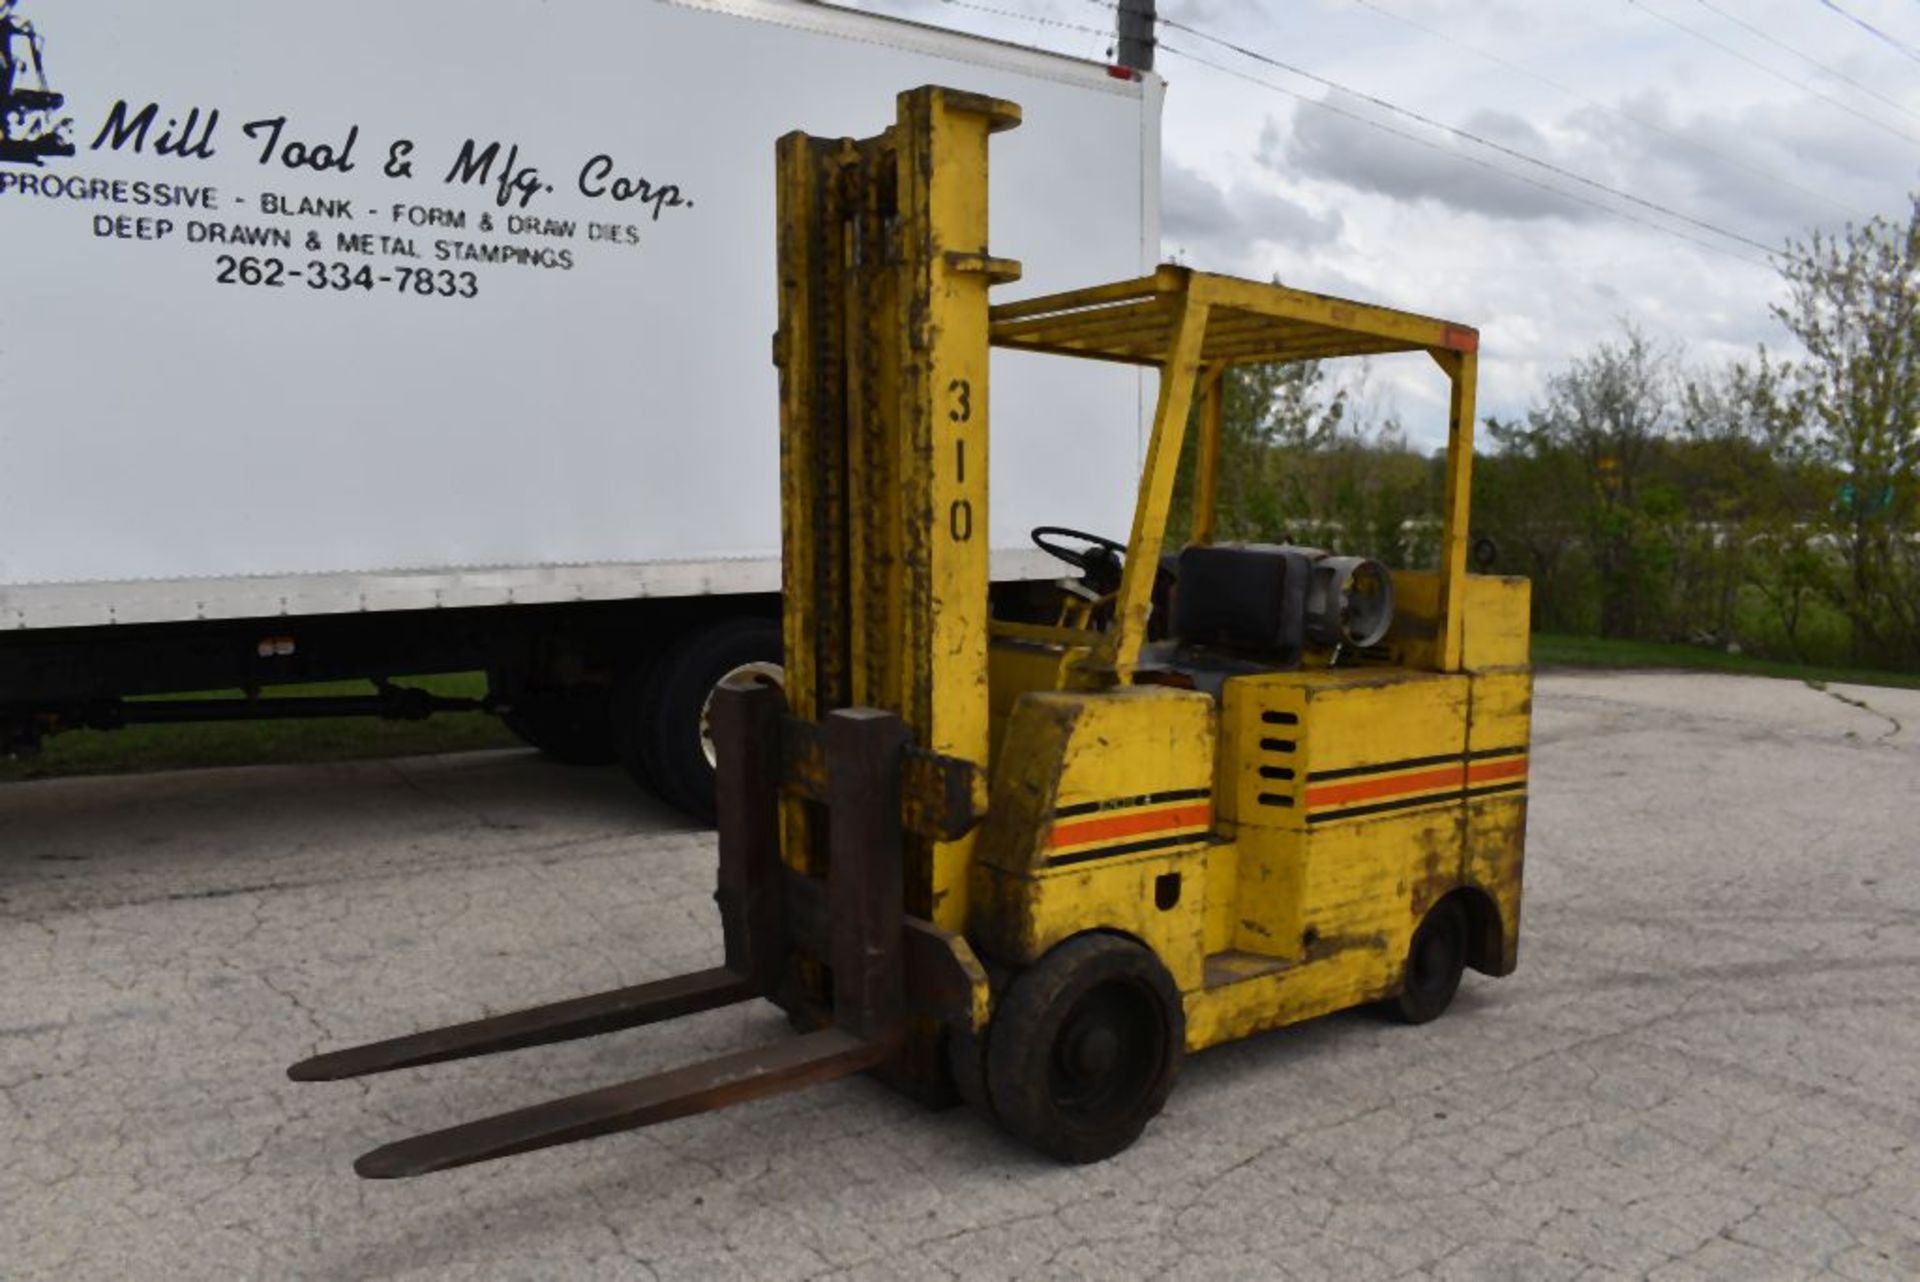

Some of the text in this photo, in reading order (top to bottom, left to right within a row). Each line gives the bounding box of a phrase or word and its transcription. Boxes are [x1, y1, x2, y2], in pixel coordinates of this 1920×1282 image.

[90, 100, 219, 159] Mill
[242, 115, 359, 173] Tool
[384, 139, 414, 178] &
[445, 138, 554, 209] Mfg.
[578, 154, 695, 221] Corp.
[0, 171, 218, 210] PROGRESSIVE
[260, 192, 353, 220] BLANK
[392, 203, 466, 228] FORM
[480, 211, 494, 233] &
[507, 214, 577, 238] DRAW
[588, 221, 641, 245] DIES
[93, 214, 574, 271] DEEP DRAWN & METAL STAMPINGS
[216, 254, 479, 299] 262-334-7833
